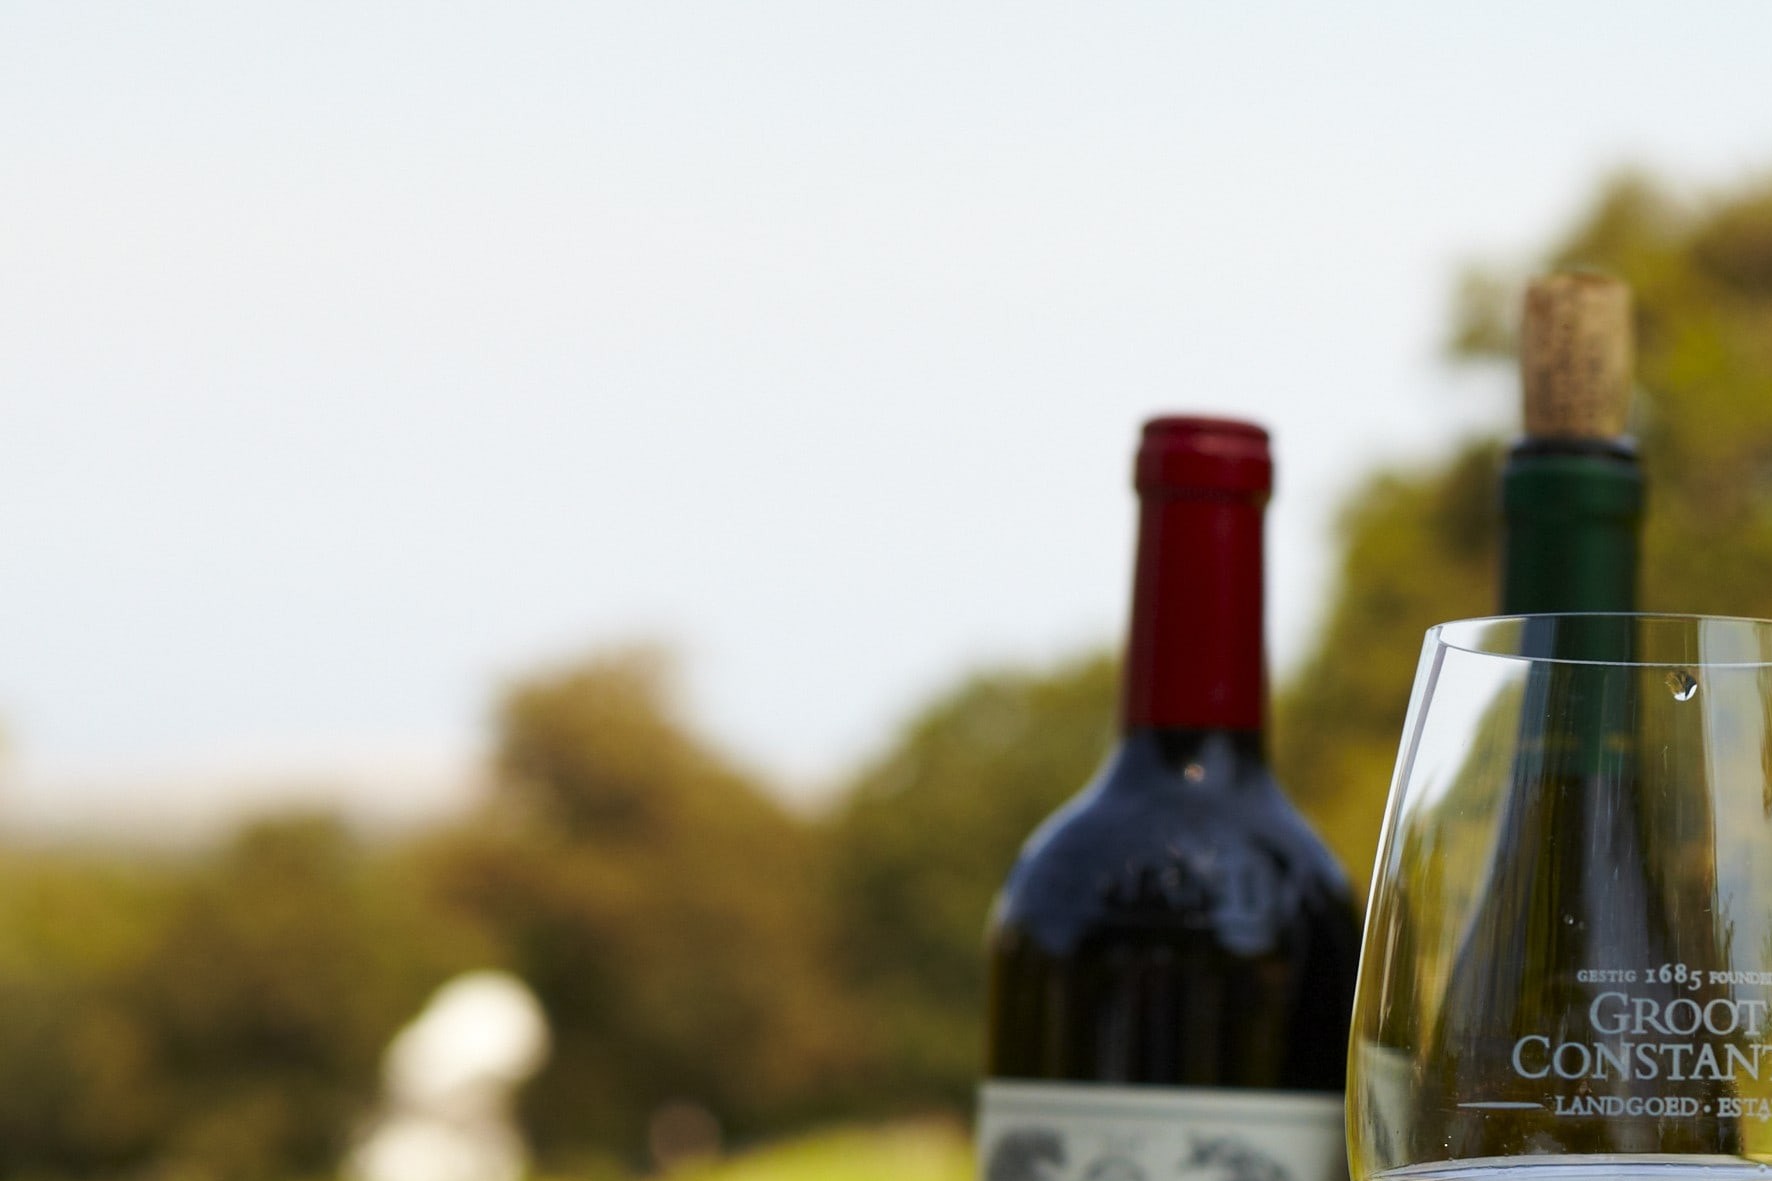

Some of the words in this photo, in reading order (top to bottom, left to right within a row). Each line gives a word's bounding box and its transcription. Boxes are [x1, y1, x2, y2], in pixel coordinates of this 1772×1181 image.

[1577, 969, 1636, 984] GESTIG
[1644, 963, 1702, 991] 1685
[1589, 991, 1769, 1037] GROOT
[1554, 1095, 1699, 1118] LANDGOED
